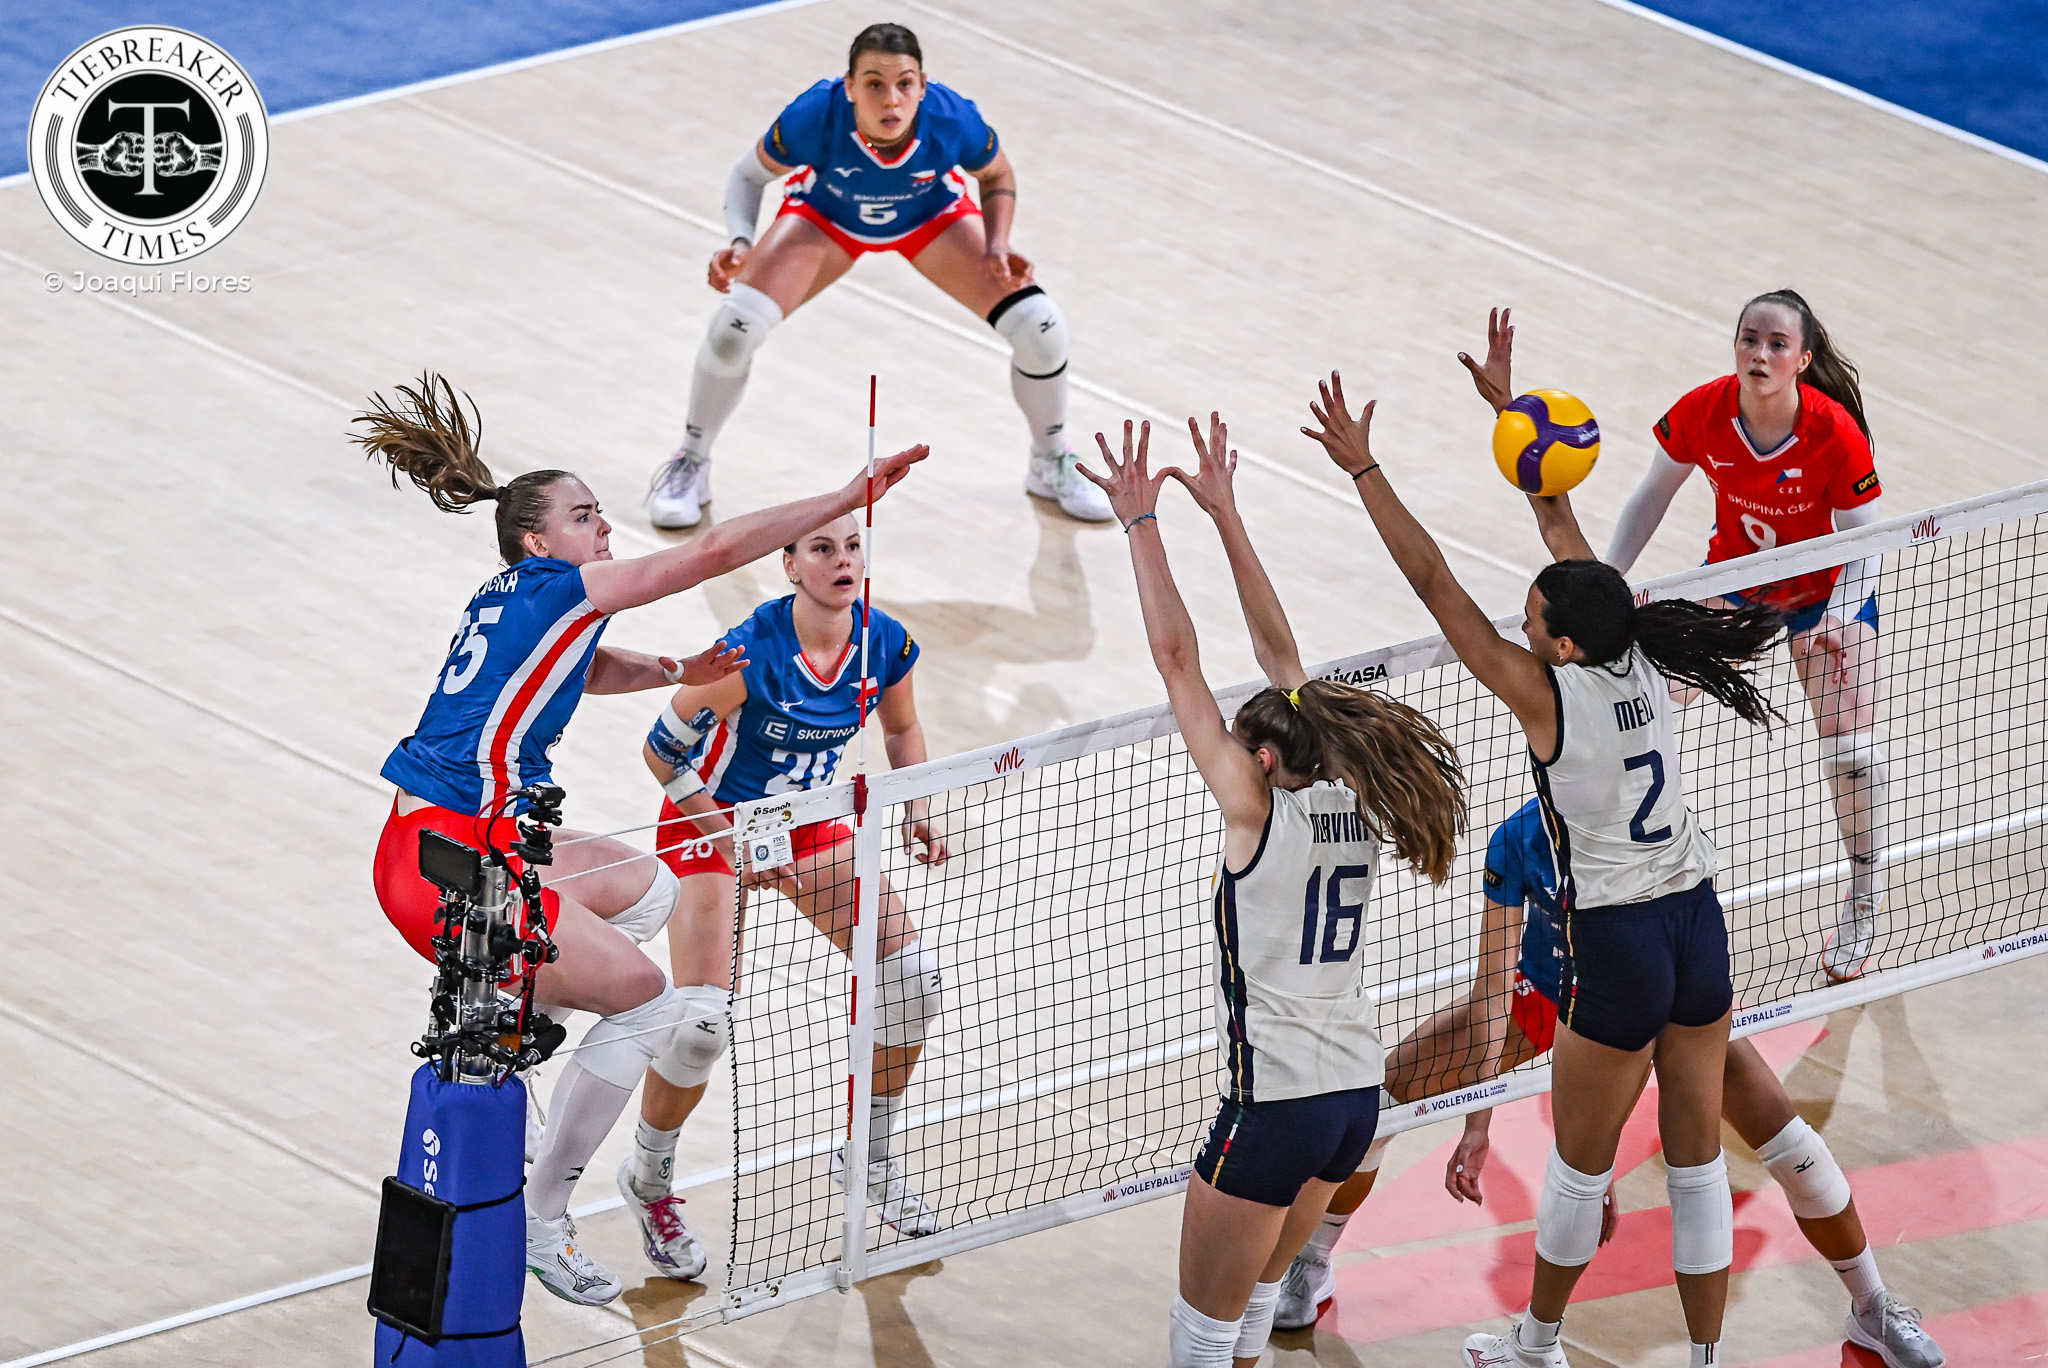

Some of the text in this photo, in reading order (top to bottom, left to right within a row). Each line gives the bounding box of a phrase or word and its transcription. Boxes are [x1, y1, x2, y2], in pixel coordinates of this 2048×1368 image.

[859, 203, 898, 225] 5
[1778, 486, 1802, 494] CZE
[1728, 493, 1784, 515] SKUPINA
[1740, 513, 1777, 552] 9
[1912, 515, 1941, 539] VNL
[796, 726, 855, 740] SKUPINA
[994, 746, 1025, 774] VNL
[1623, 749, 1672, 843] 2
[762, 802, 792, 815] Senoh
[681, 838, 714, 861] 20
[1299, 864, 1369, 965] 16
[1731, 1009, 1775, 1029] LLEYBALL
[1431, 1088, 1490, 1111] VOLLEYBALL
[1120, 1173, 1180, 1197] VOLLEYBALL
